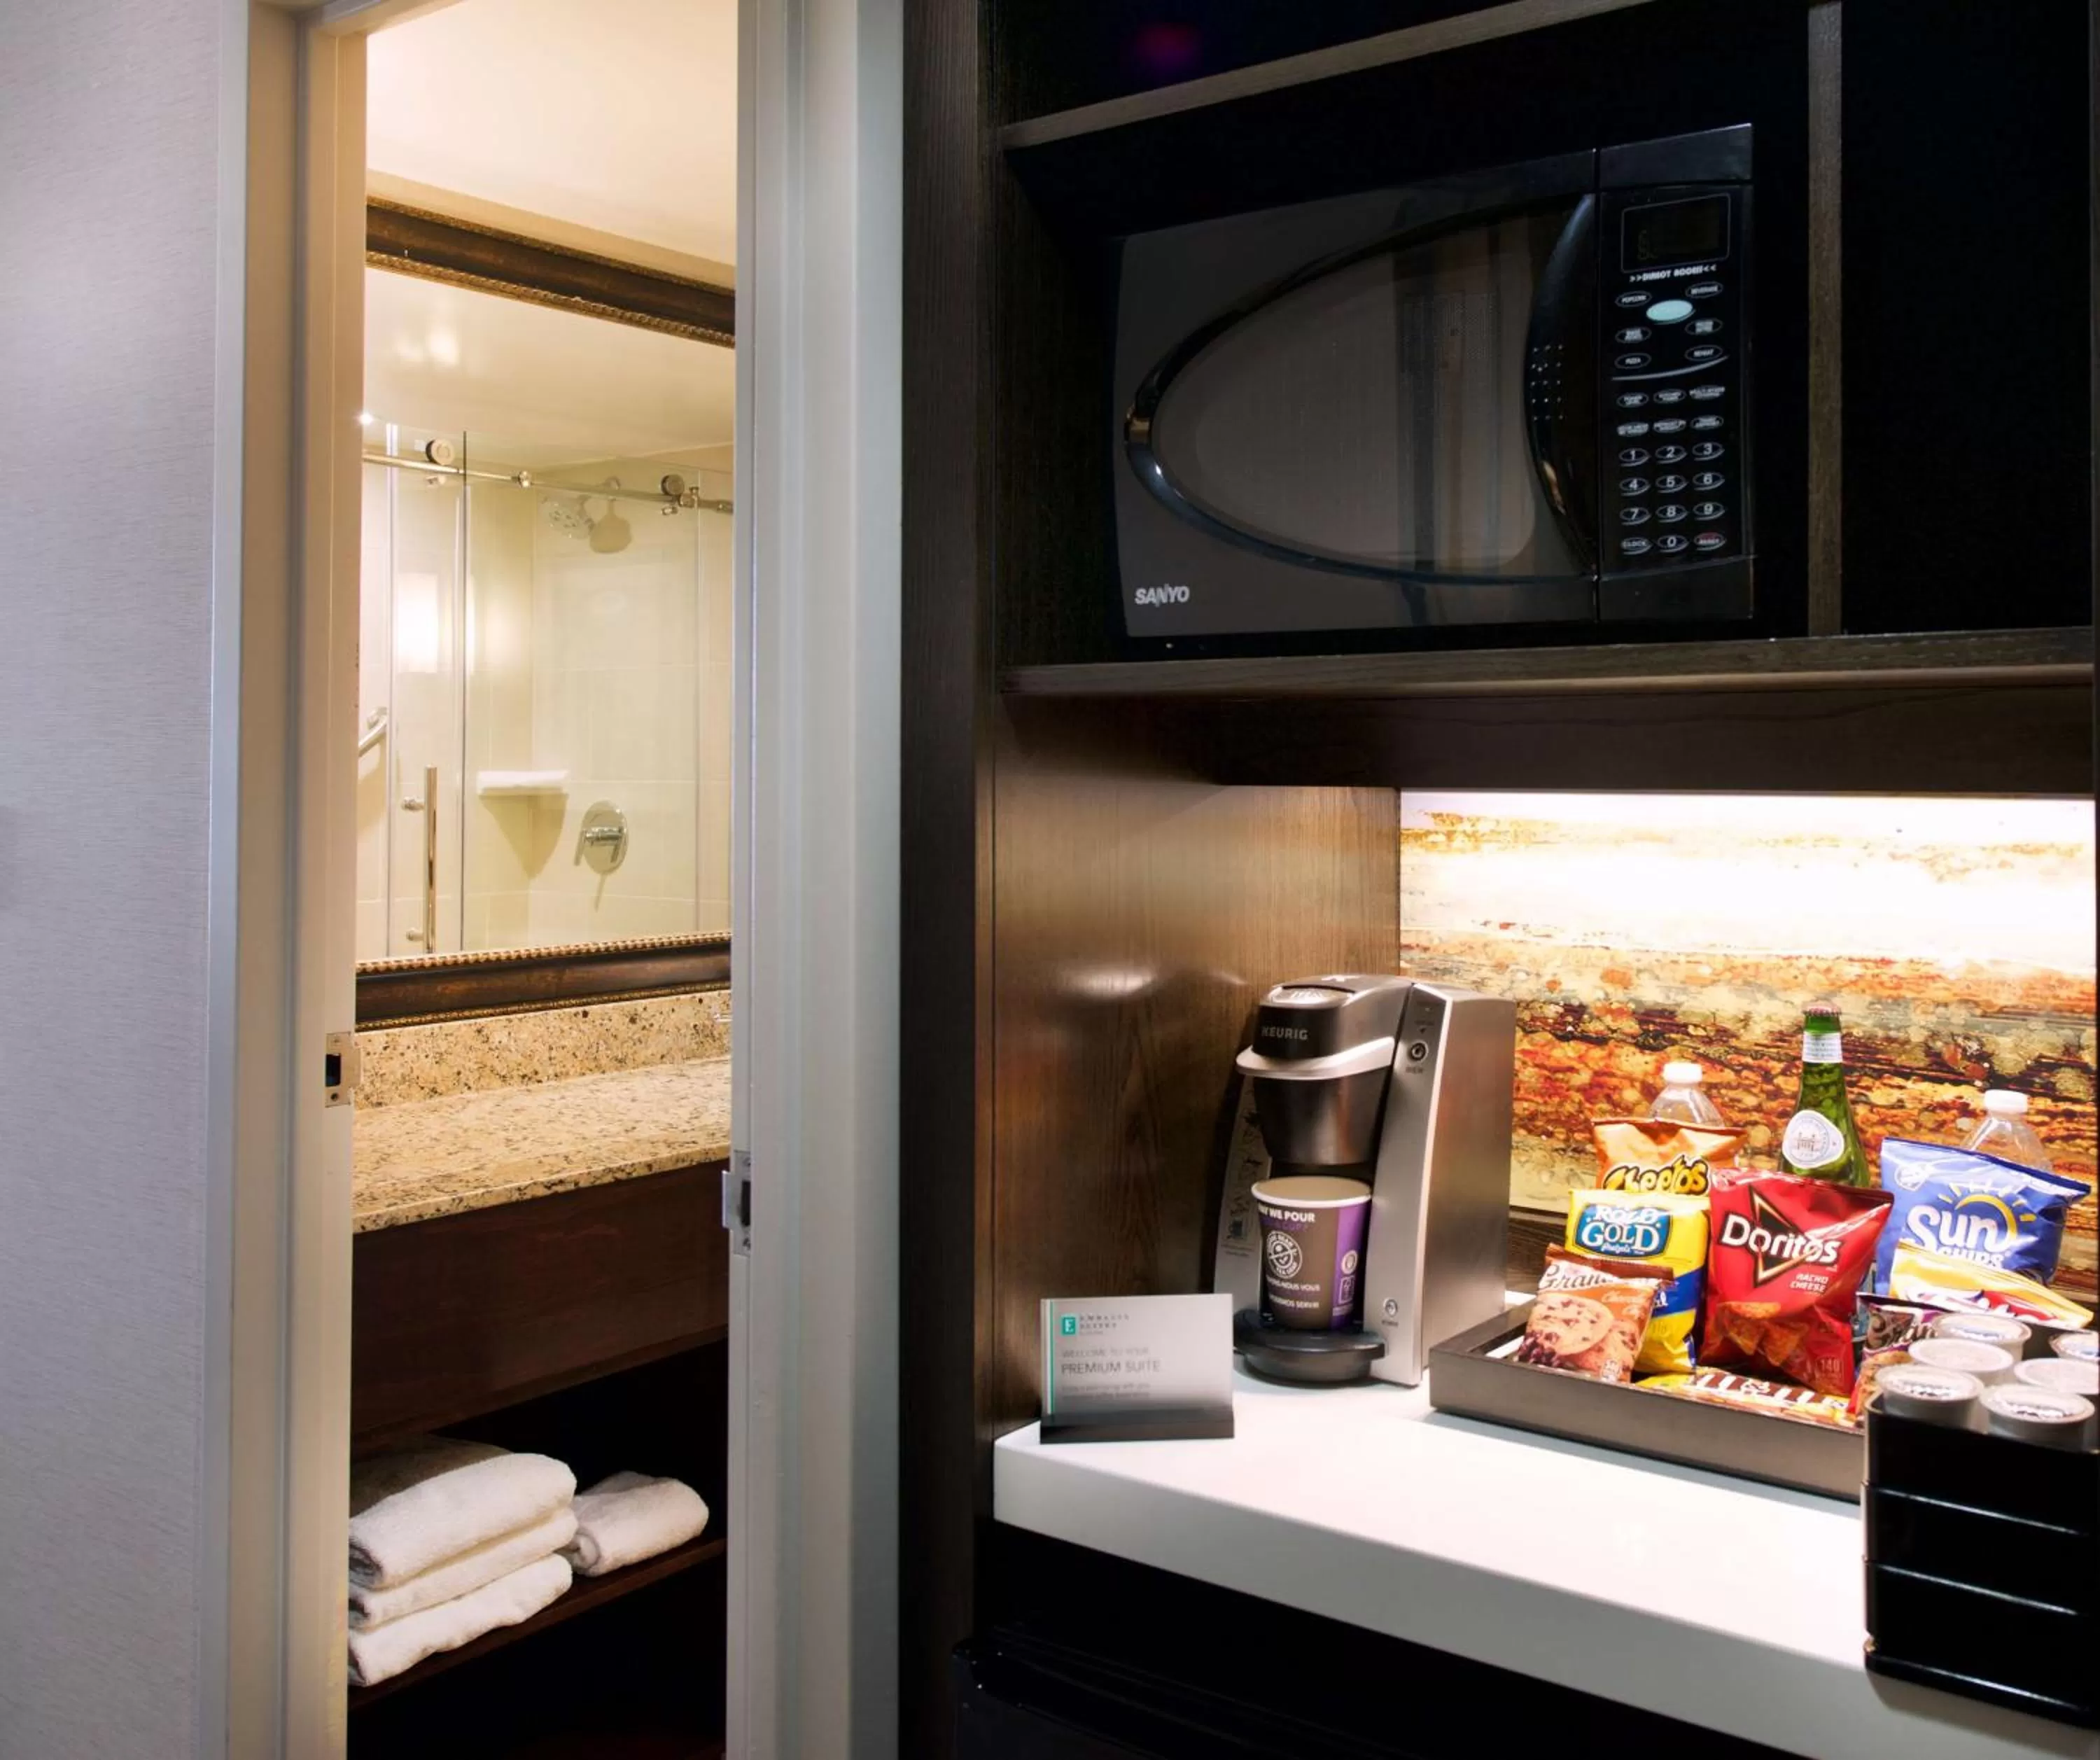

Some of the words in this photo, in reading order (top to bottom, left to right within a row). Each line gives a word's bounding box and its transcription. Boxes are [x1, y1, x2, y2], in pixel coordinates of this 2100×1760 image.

[1630, 450, 1636, 460] 1
[1667, 446, 1675, 458] 2
[1704, 443, 1713, 455] 3
[1629, 478, 1637, 490] 4
[1667, 475, 1675, 488] 5
[1703, 473, 1712, 484] 6
[1630, 508, 1639, 520] 7
[1667, 505, 1676, 517] 8
[1704, 503, 1713, 514] 9
[1667, 536, 1676, 547] 0
[1134, 583, 1190, 608] SANYO
[1261, 1026, 1309, 1040] KEURIG
[1284, 1210, 1315, 1223] POUR
[1907, 1204, 2015, 1255] Sun
[1721, 1213, 1842, 1264] Doritos
[1795, 1273, 1829, 1285] NACHO
[1789, 1280, 1826, 1293] CHEESE
[1060, 1360, 1121, 1374] PREMIUM
[1125, 1359, 1161, 1373] SUITE
